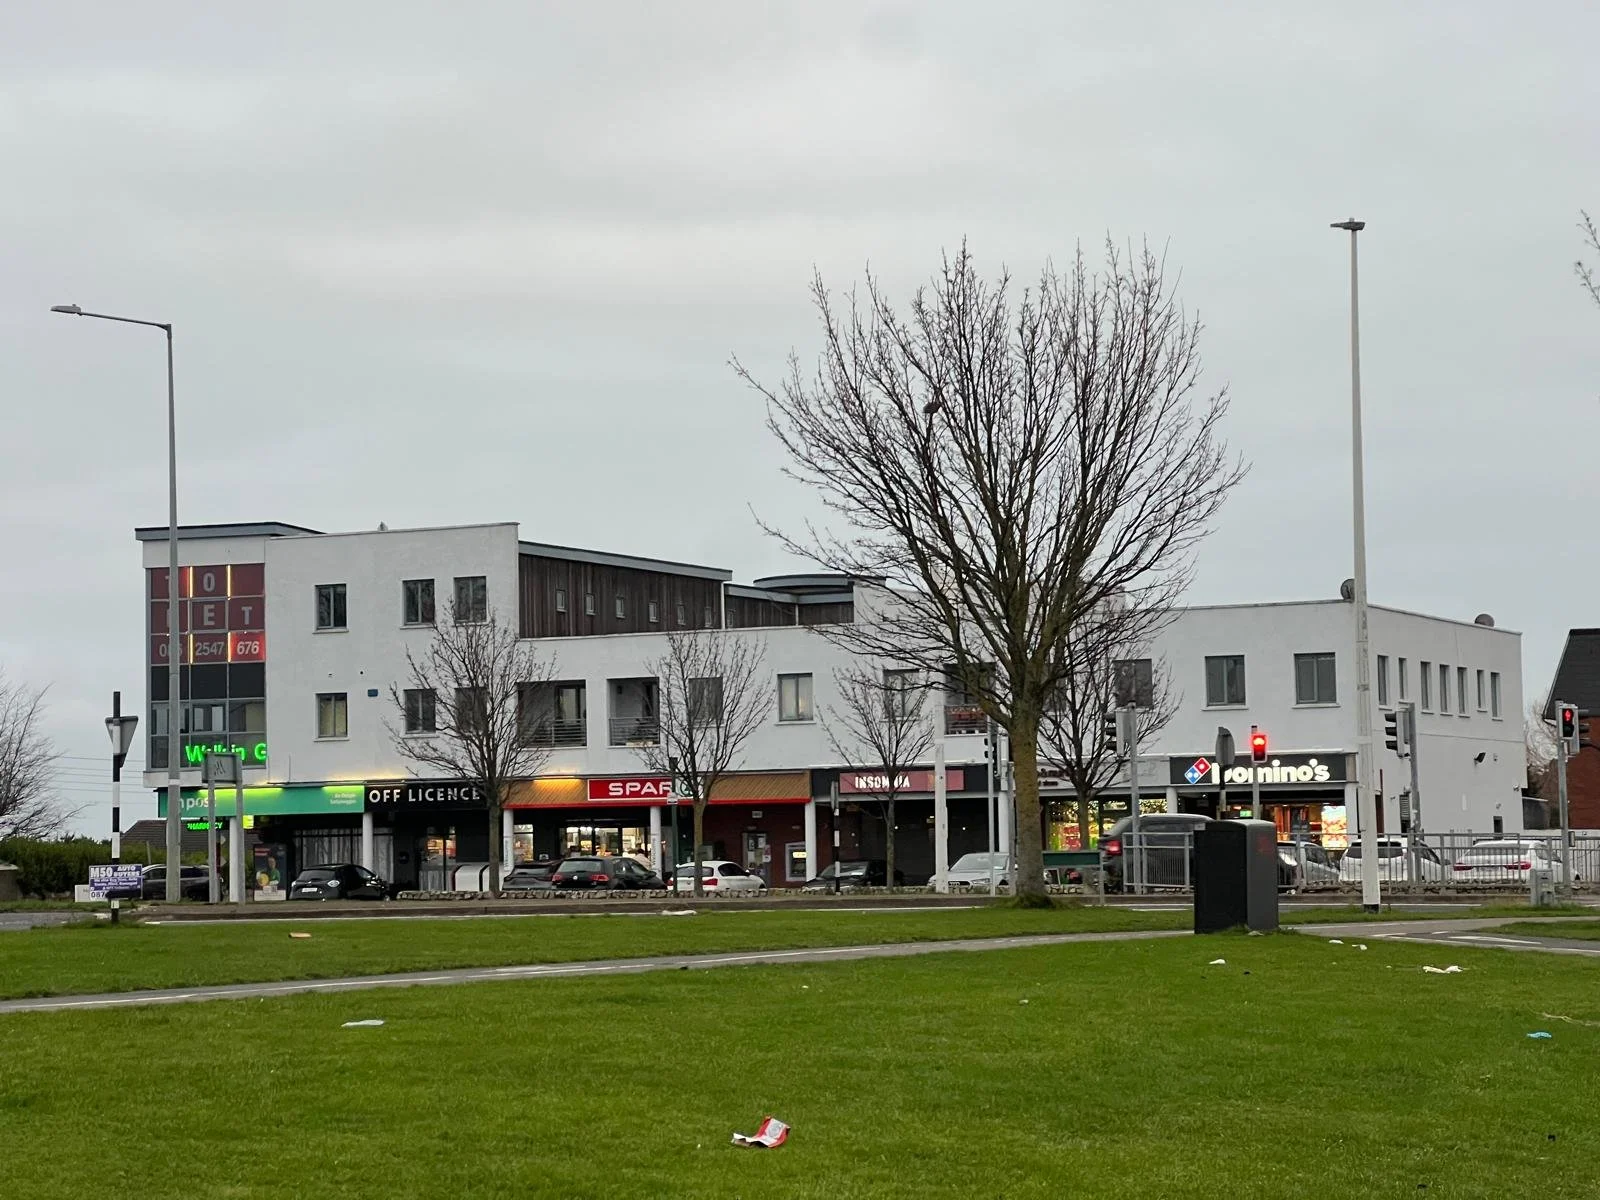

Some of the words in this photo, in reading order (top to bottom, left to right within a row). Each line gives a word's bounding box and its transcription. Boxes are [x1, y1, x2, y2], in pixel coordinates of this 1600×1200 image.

[196, 641, 225, 656] 2547
[236, 641, 260, 655] 676
[369, 789, 401, 803] OFF
[408, 787, 481, 802] LICENCE
[608, 781, 672, 796] SPAR
[91, 867, 113, 878] M50
